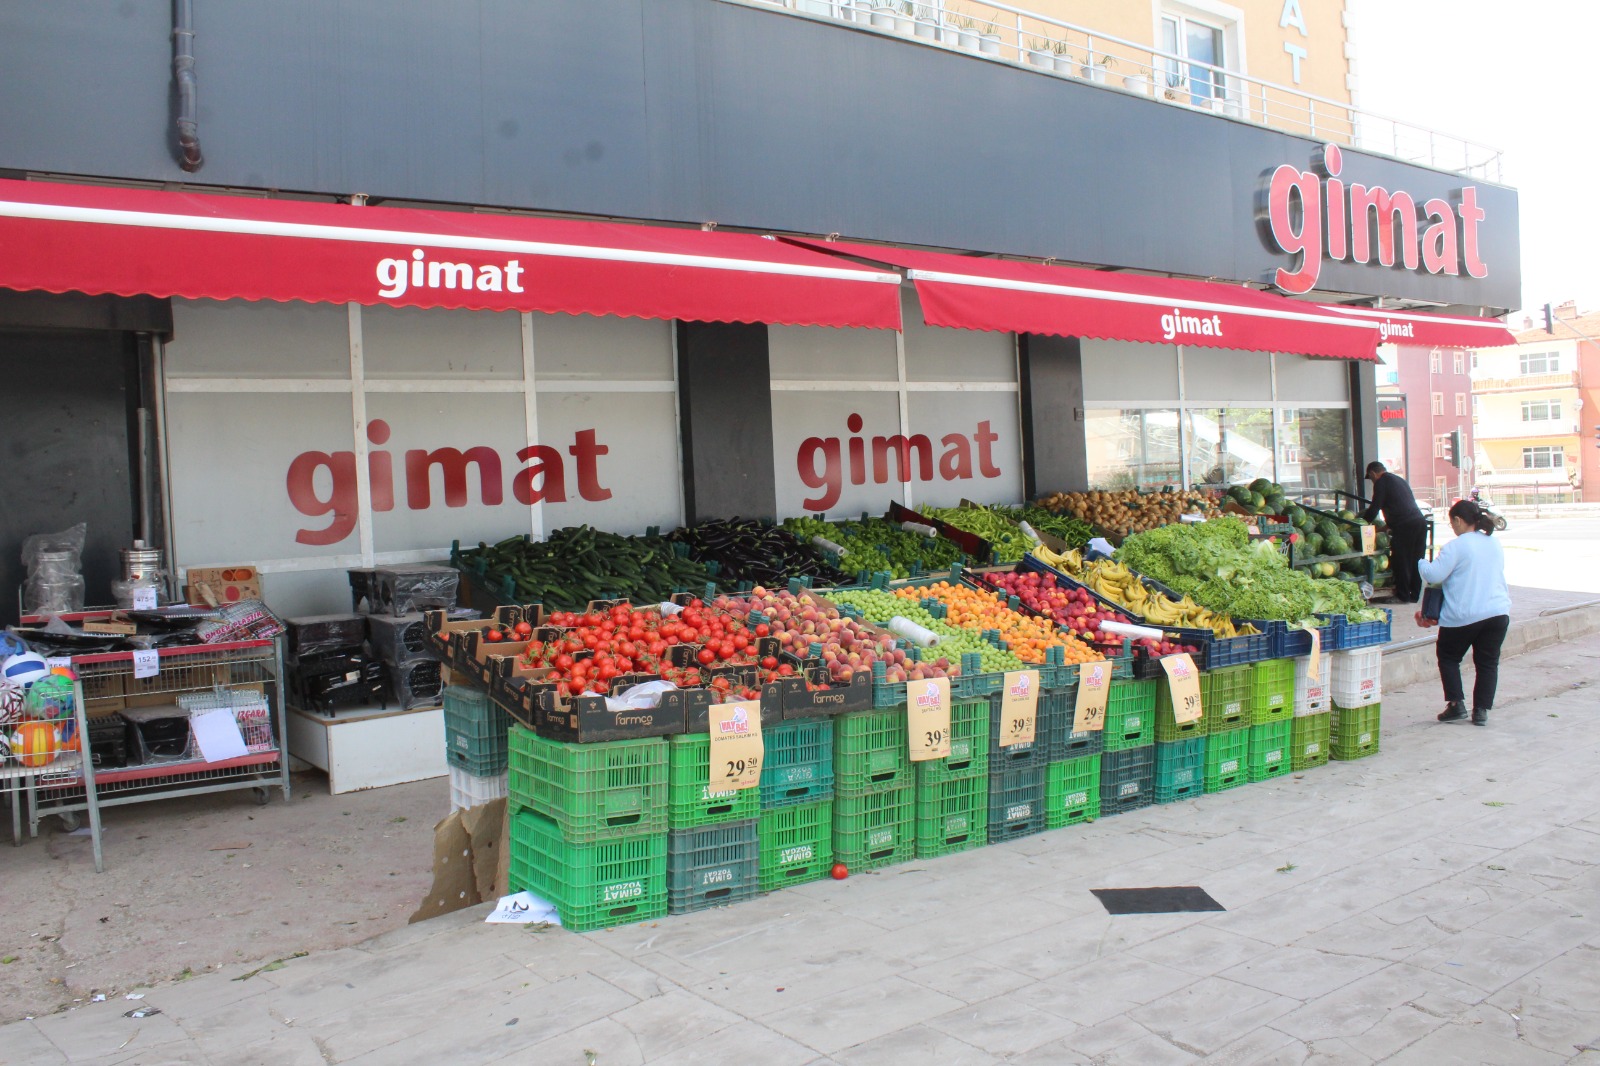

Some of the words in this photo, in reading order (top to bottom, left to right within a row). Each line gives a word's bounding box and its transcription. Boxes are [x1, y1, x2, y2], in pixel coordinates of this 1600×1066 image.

[1268, 143, 1488, 294] gimat
[376, 249, 525, 298] gimat
[1161, 308, 1223, 339] gimat
[1380, 318, 1414, 340] gimat
[1381, 405, 1405, 422] gimat
[797, 413, 1001, 511] gimat
[287, 419, 613, 545] gimat
[1084, 706, 1097, 720] 29
[1184, 696, 1194, 710] 39
[1011, 718, 1024, 734] 39
[925, 729, 941, 747] 39
[726, 759, 745, 777] 29
[747, 757, 758, 766] 50
